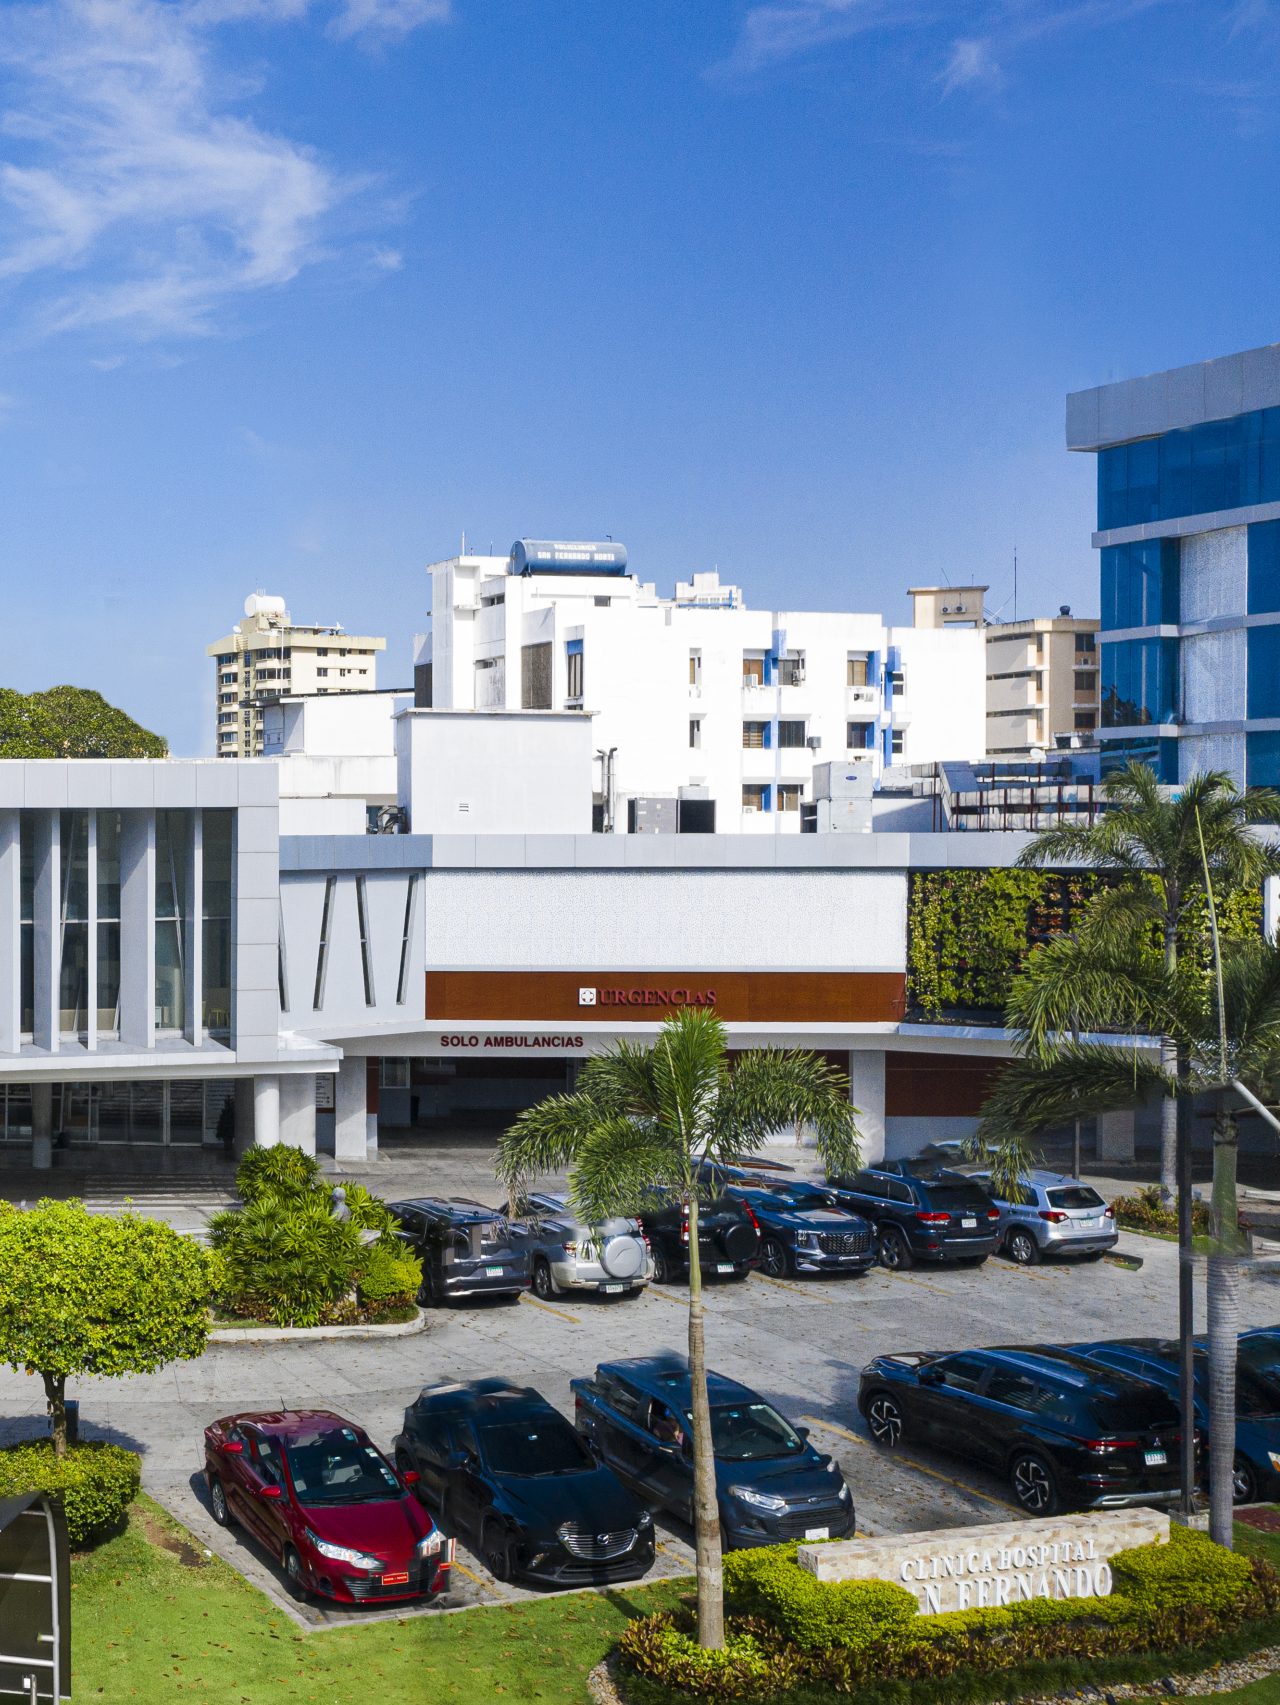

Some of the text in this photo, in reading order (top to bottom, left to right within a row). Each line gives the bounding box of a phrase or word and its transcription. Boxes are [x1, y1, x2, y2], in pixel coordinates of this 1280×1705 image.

[599, 988, 717, 1005] URGENCIAS
[440, 1036, 584, 1048] SOLO AMBULANCIAS
[900, 1538, 1099, 1582] CLINICA HOSPITAL
[955, 1562, 1113, 1608] FERNANDO
